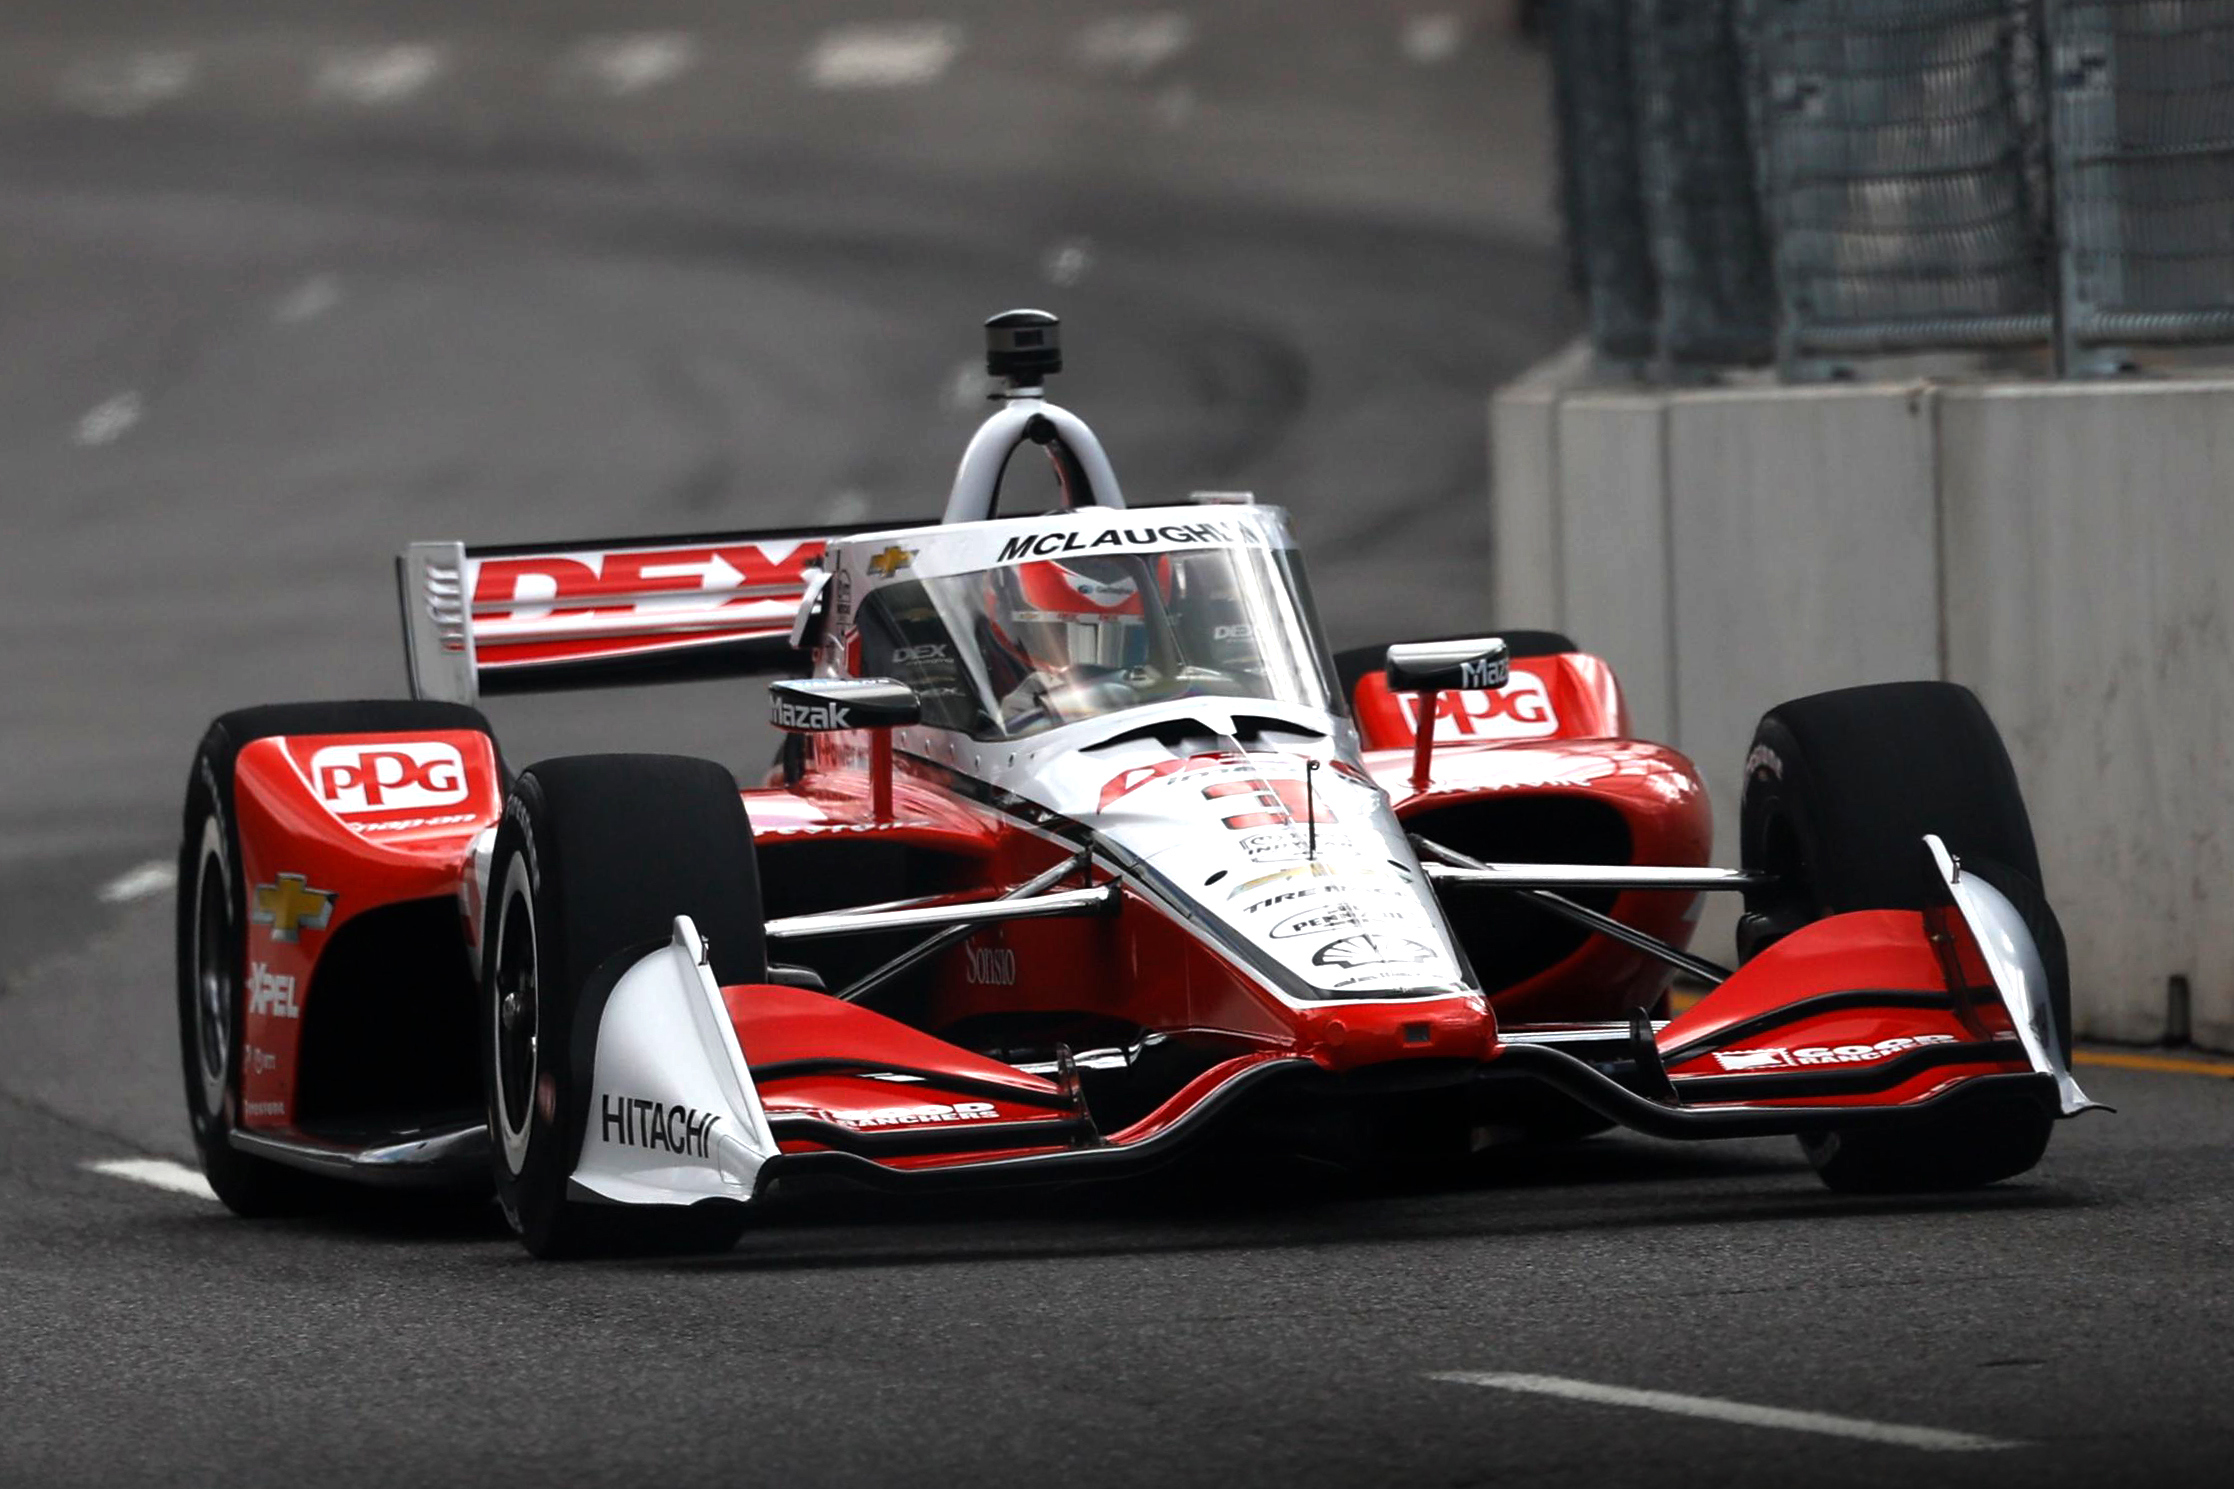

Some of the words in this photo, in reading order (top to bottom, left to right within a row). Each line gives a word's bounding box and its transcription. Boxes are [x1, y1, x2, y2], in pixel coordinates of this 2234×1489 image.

[996, 519, 1261, 563] MCLAUGHLN
[892, 644, 947, 662] DEX
[770, 693, 850, 729] Mazak
[321, 752, 460, 805] PPG
[1243, 886, 1317, 913] TIRE
[1793, 1035, 1954, 1057] GOOD
[1797, 1040, 1960, 1064] RANCHE
[602, 1094, 721, 1158] HITACHI
